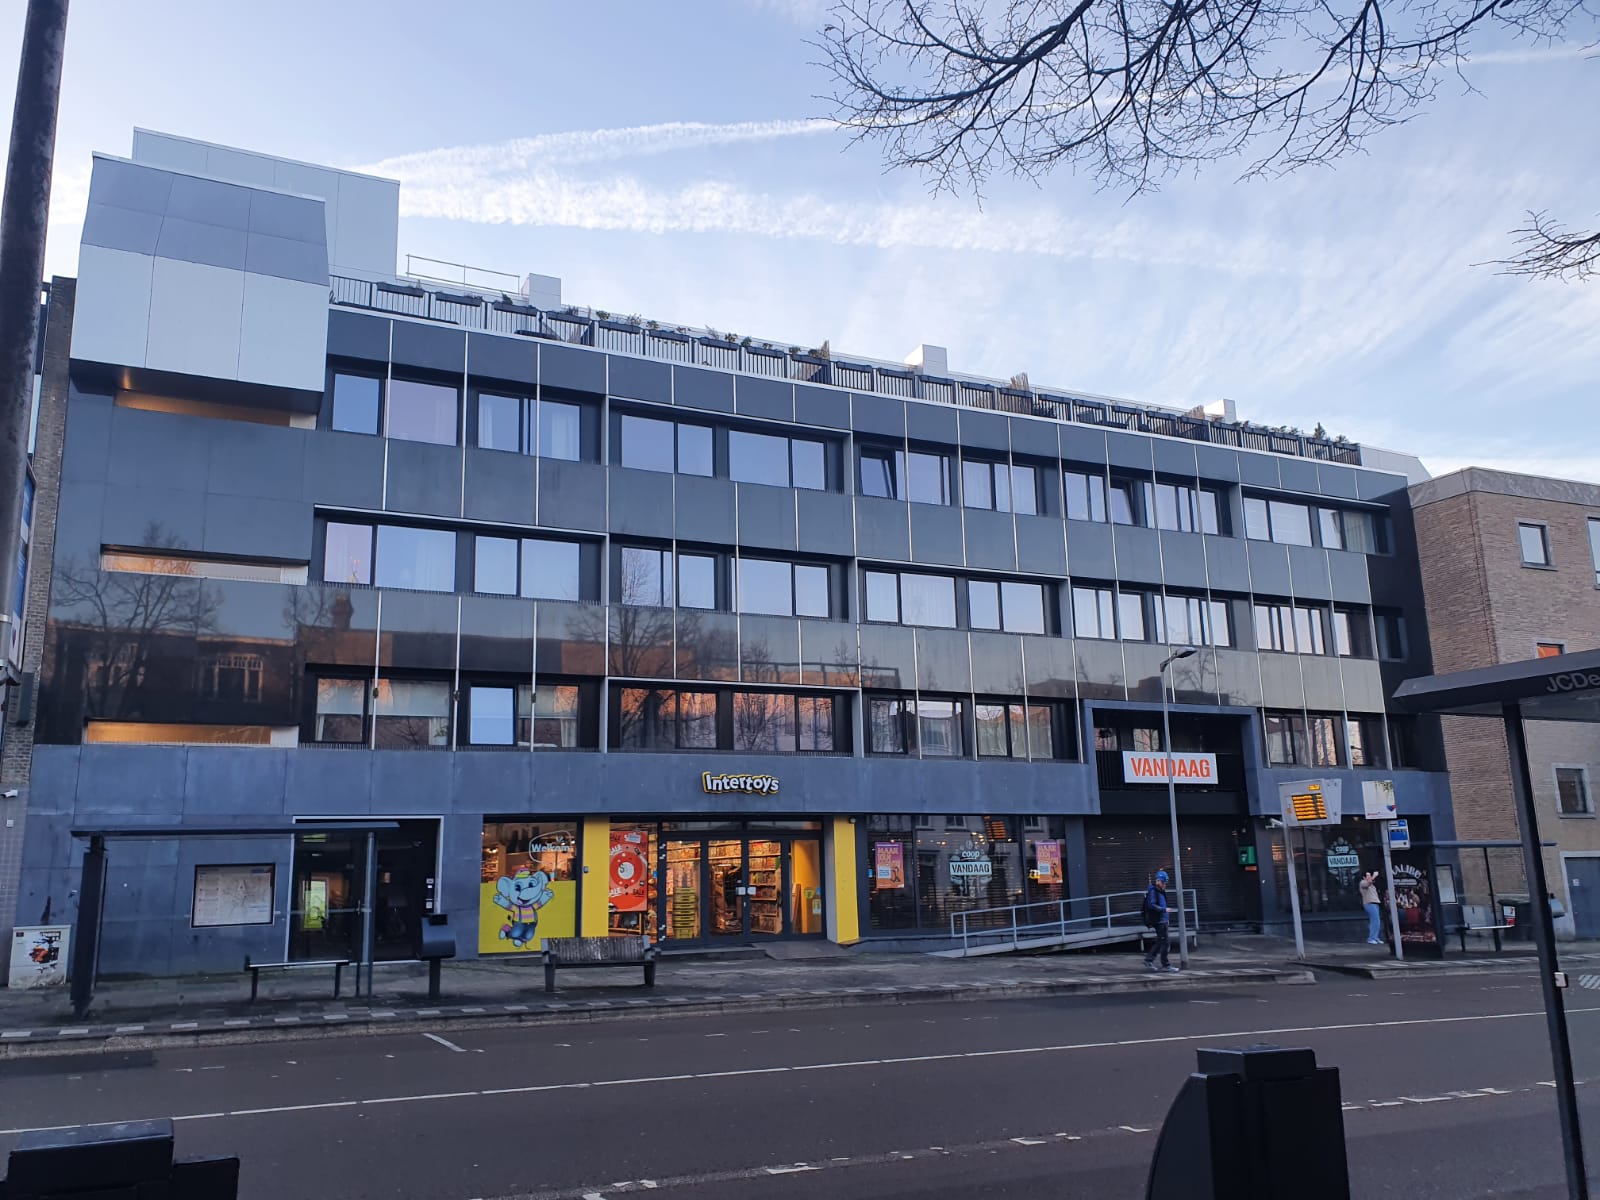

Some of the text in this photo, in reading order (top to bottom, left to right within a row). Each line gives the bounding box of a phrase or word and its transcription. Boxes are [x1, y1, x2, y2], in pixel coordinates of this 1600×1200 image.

[1546, 673, 1600, 691] JCDe
[1130, 757, 1211, 777] VANDAAG
[704, 773, 780, 794] Intertoys
[531, 842, 570, 852] Welkom
[951, 863, 990, 873] VANDAAG
